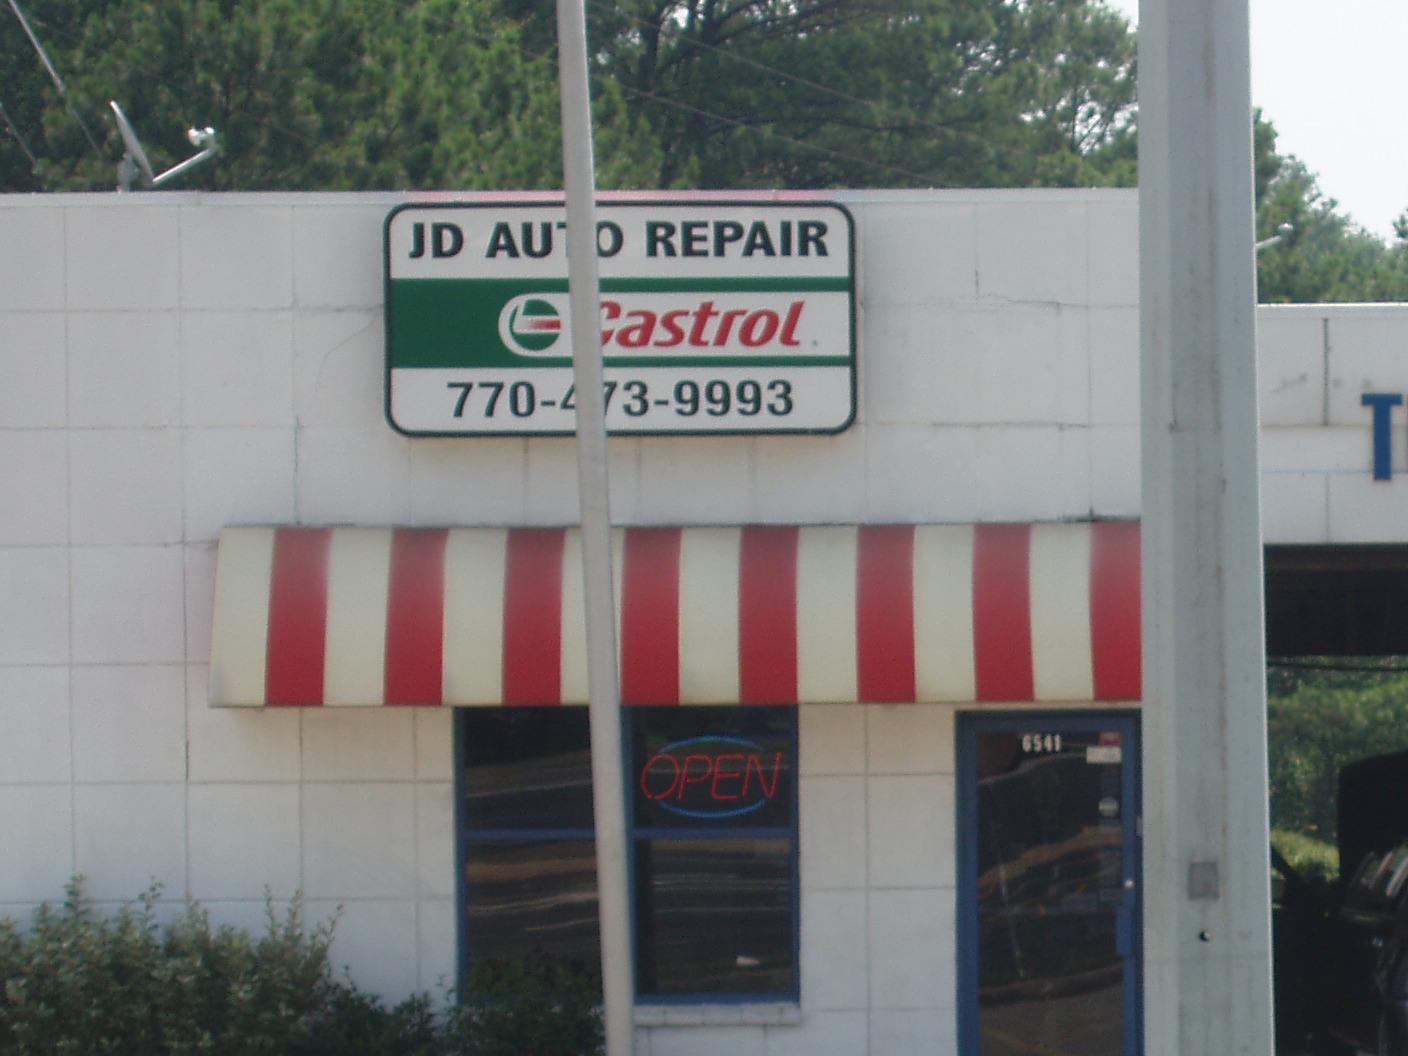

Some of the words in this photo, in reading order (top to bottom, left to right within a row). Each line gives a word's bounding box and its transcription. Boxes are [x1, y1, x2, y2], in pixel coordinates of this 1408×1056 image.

[408, 221, 464, 258] JD
[485, 220, 624, 258] AUO
[646, 220, 829, 257] REPAIR
[1022, 734, 1061, 752] 6541
[640, 751, 783, 801] OPEN
